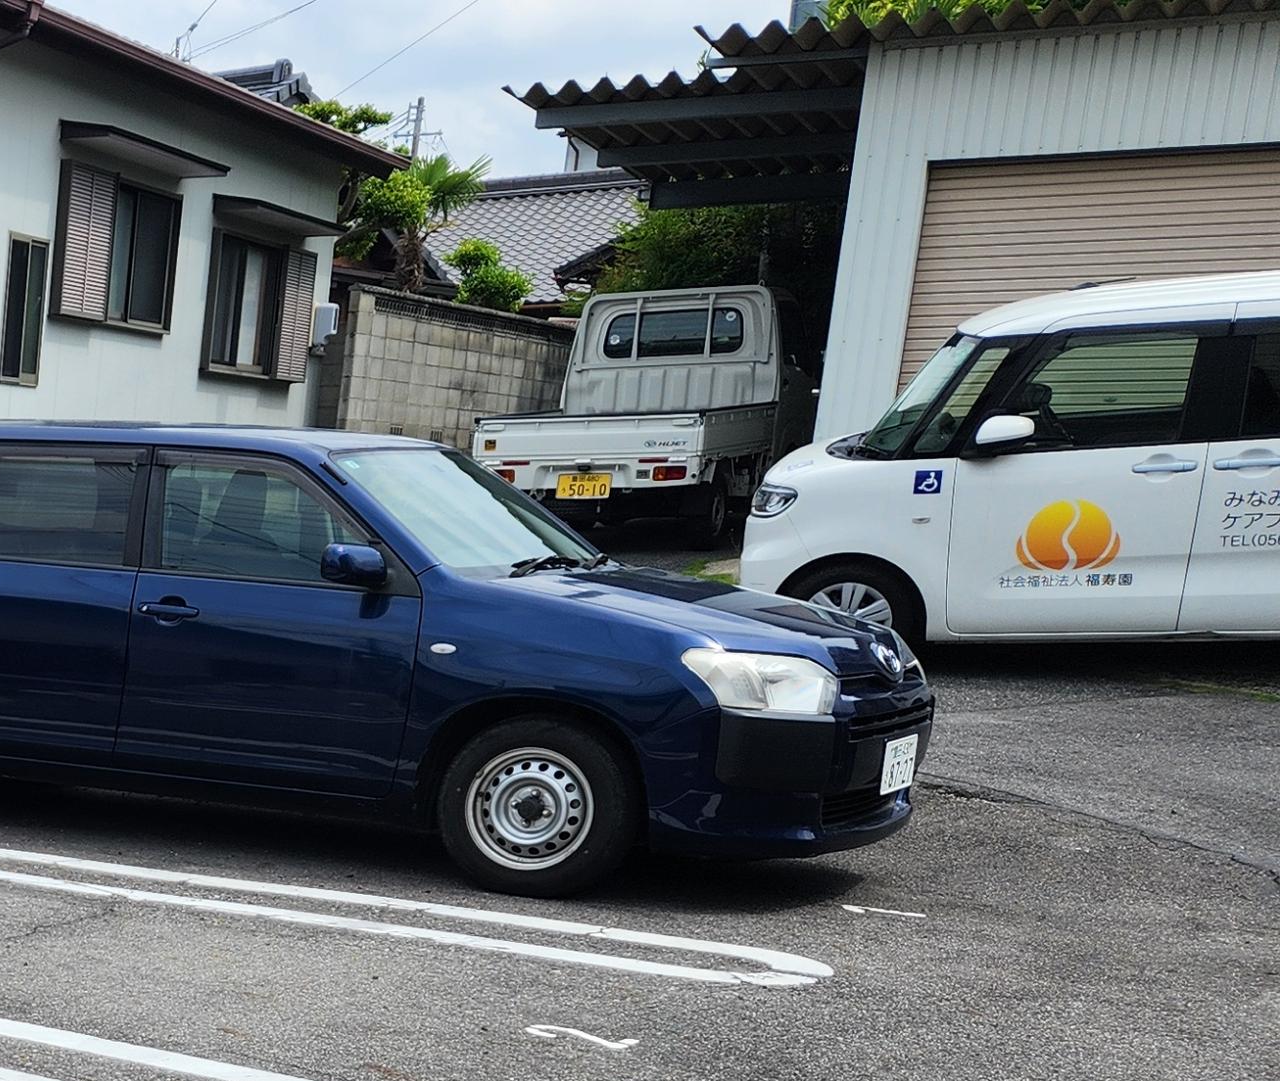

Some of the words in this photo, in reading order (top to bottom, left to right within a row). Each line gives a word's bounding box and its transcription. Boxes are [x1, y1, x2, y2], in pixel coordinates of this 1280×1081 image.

[569, 483, 607, 496] 50-10
[1220, 533, 1280, 547] TEL(05
[525, 1024, 639, 1050] 2
